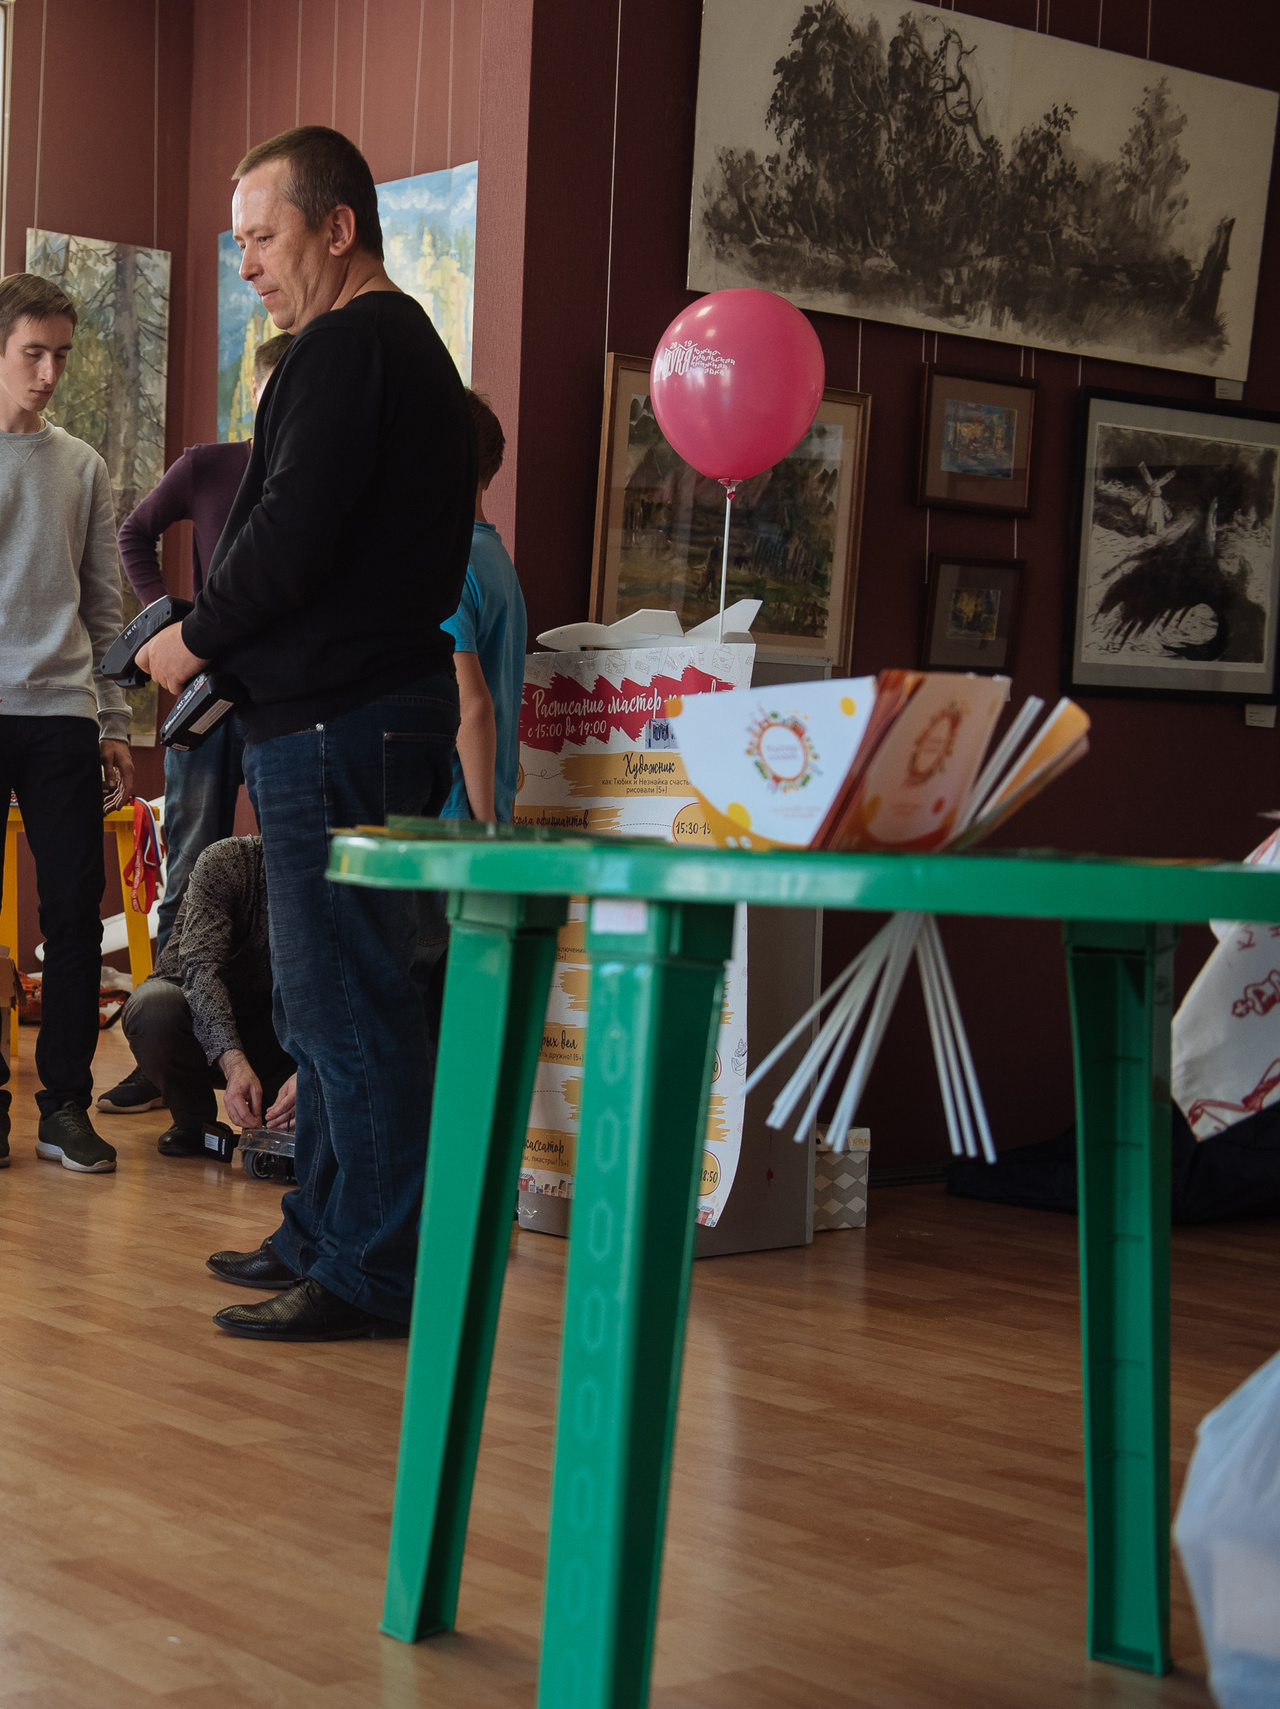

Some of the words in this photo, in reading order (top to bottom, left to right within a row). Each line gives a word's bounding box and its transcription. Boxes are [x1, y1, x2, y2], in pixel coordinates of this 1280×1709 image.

[532, 689, 606, 719] Расписание
[535, 723, 563, 739] 15:00
[565, 716, 577, 737] до
[579, 720, 607, 736] 19:00
[622, 752, 677, 779] Художник
[613, 777, 632, 786] Тюбик
[638, 777, 669, 786] Незнайка
[626, 787, 655, 795] рисовали
[513, 815, 534, 826] кола
[560, 1029, 579, 1050] дел
[524, 1138, 565, 1162] кассатор
